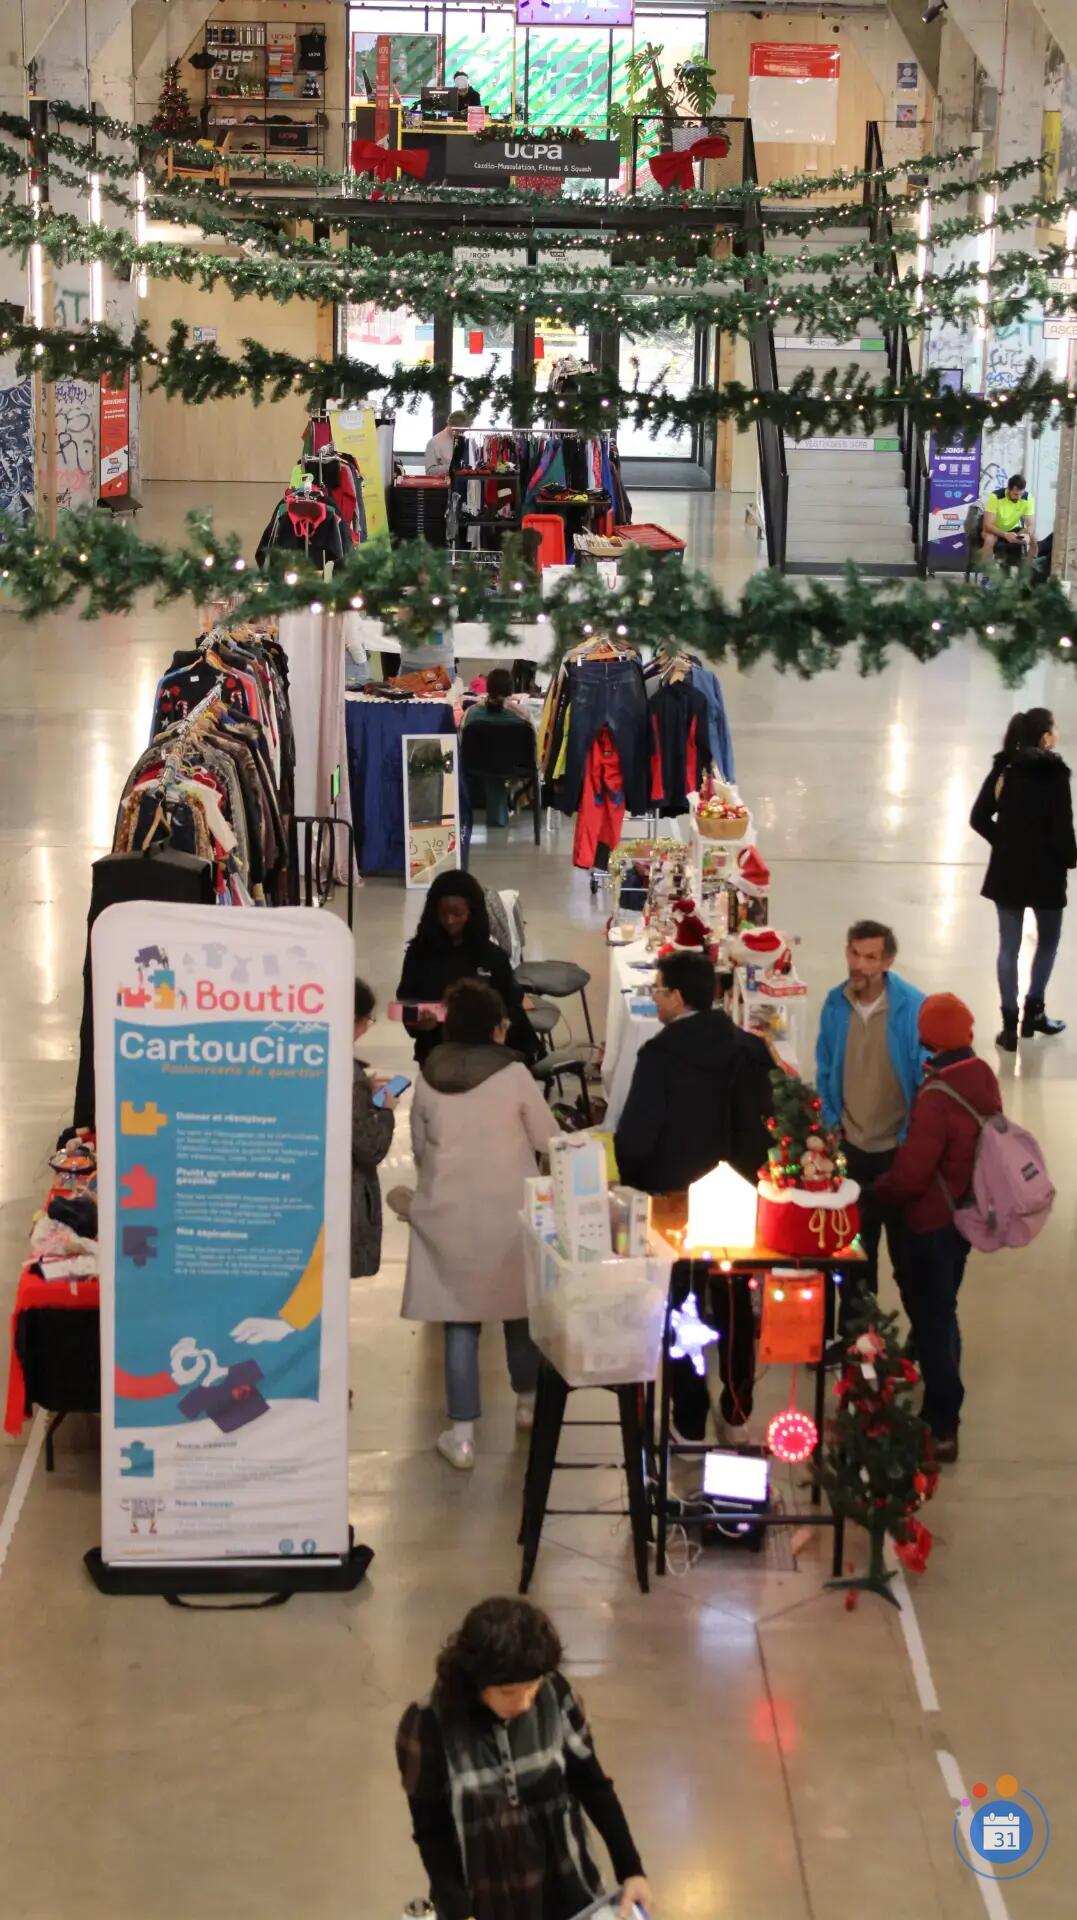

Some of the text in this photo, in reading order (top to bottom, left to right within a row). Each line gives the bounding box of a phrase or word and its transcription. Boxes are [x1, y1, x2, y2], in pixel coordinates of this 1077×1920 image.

[538, 164, 561, 172] Fitness
[570, 164, 592, 173] Squash
[196, 980, 325, 1014] BoutiC
[119, 1031, 325, 1066] CartouCirc
